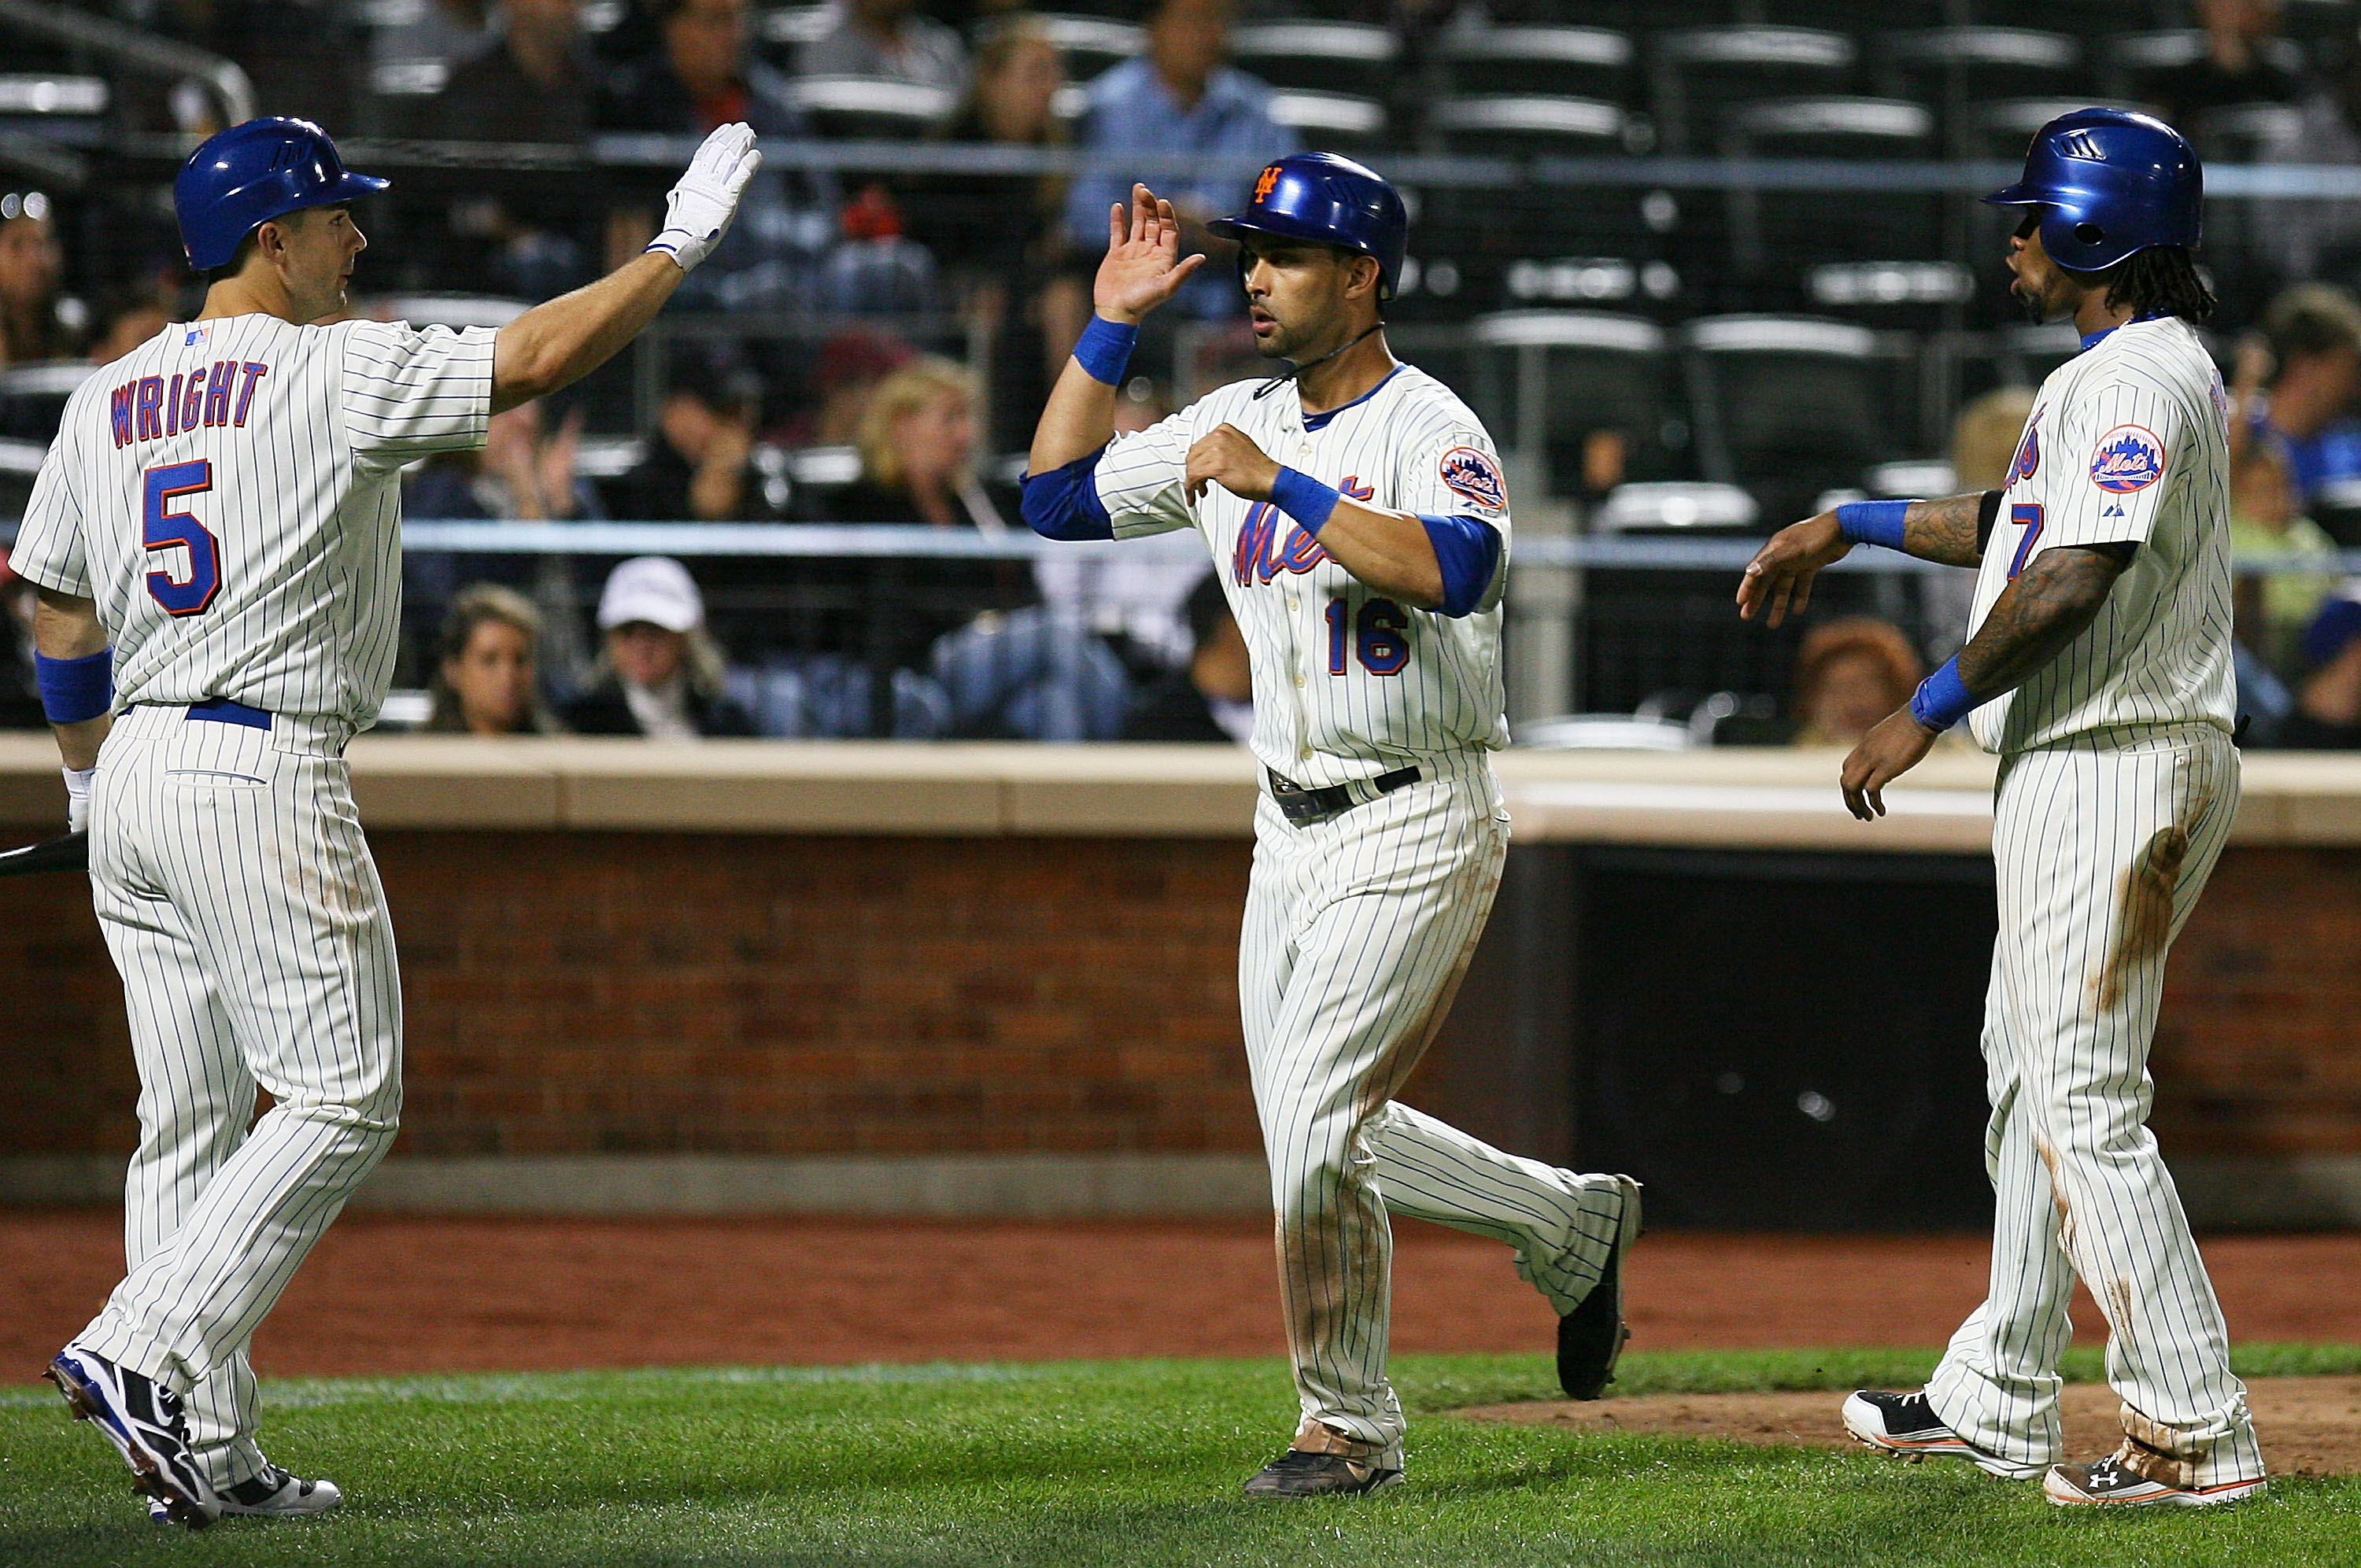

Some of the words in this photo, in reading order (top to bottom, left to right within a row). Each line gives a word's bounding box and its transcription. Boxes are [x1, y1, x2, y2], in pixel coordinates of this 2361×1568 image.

[111, 360, 268, 449] WRIGHT
[1450, 468, 1495, 494] Mets
[2099, 452, 2149, 474] Mets
[142, 458, 223, 618] 5
[1233, 474, 1375, 588] Me
[2007, 503, 2045, 581] 7
[1325, 597, 1410, 677] 16
